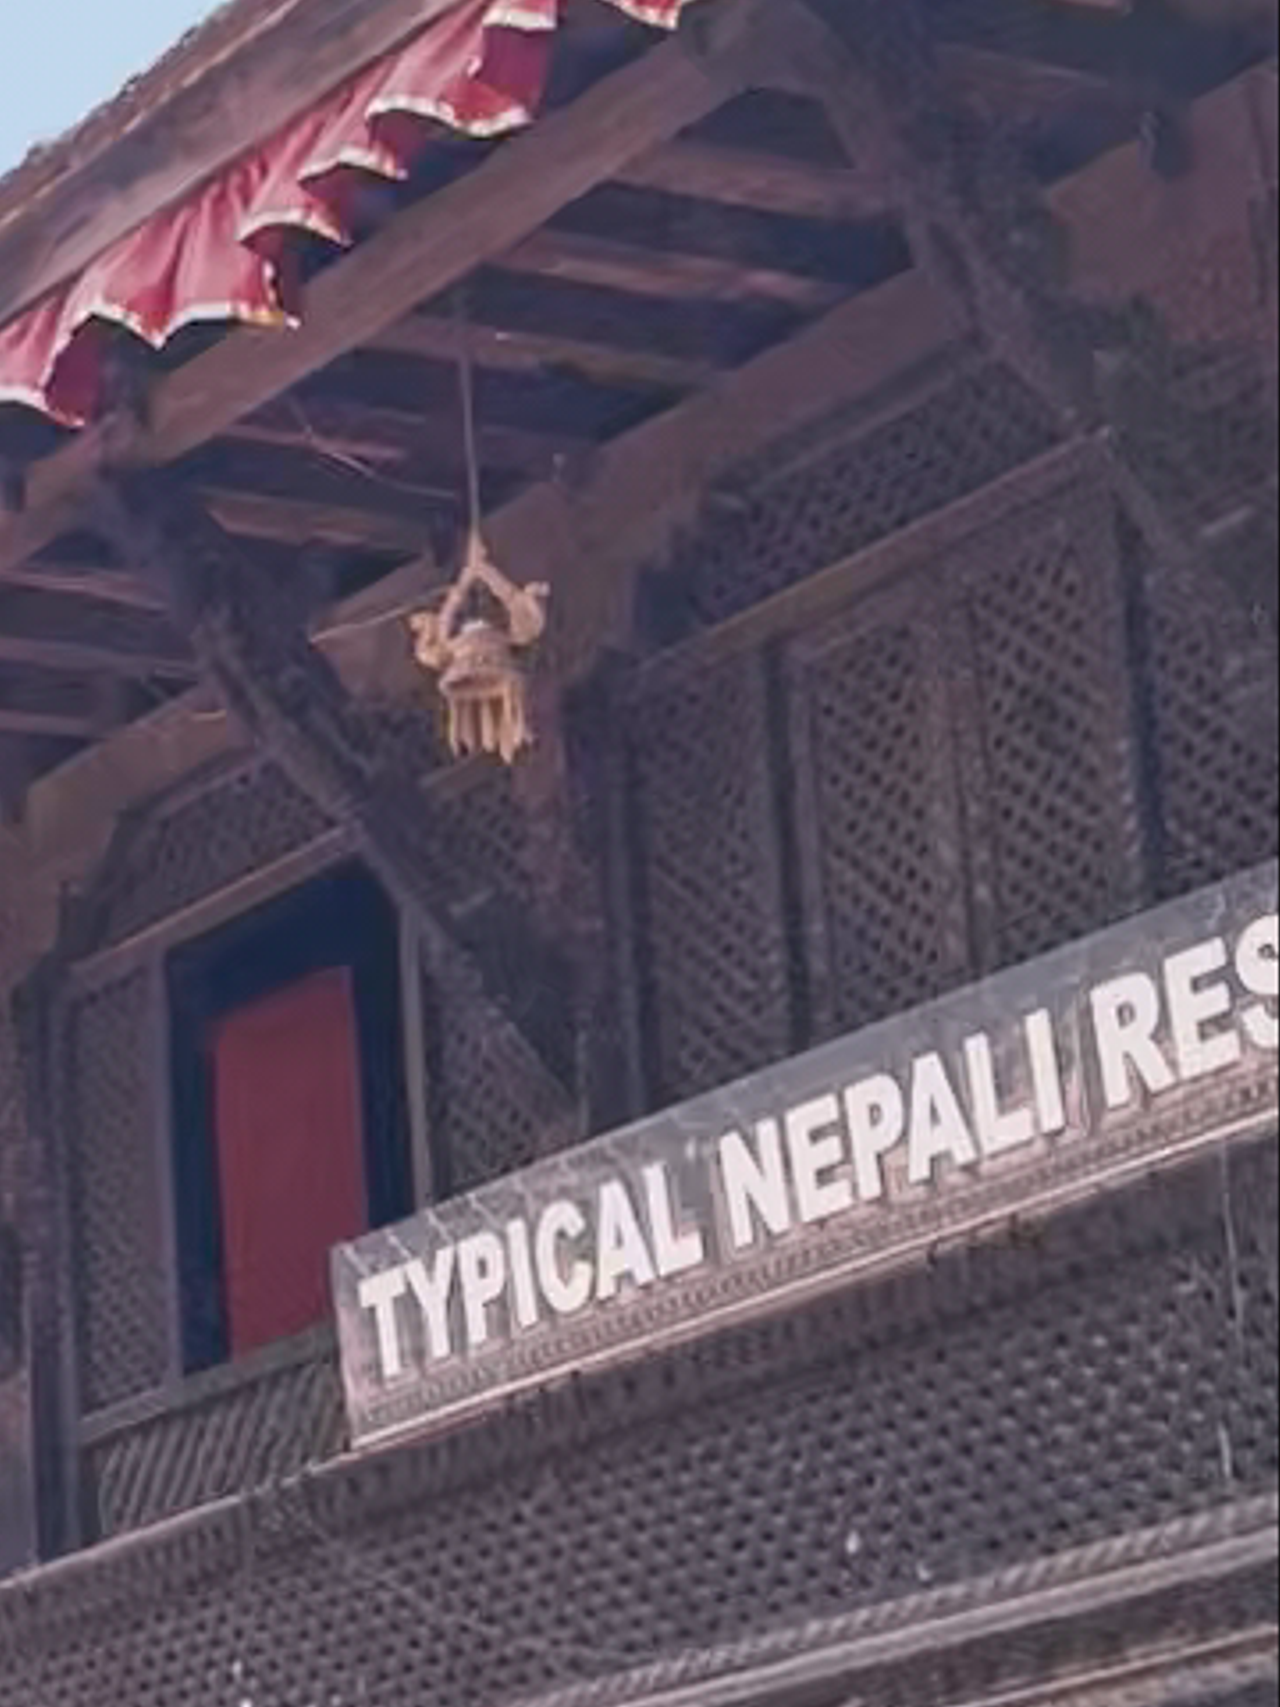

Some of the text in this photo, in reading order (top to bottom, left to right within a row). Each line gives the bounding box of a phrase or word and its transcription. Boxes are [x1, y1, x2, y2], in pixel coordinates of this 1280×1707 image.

[357, 914, 1278, 1377] TYPICAL NEPALI RES
